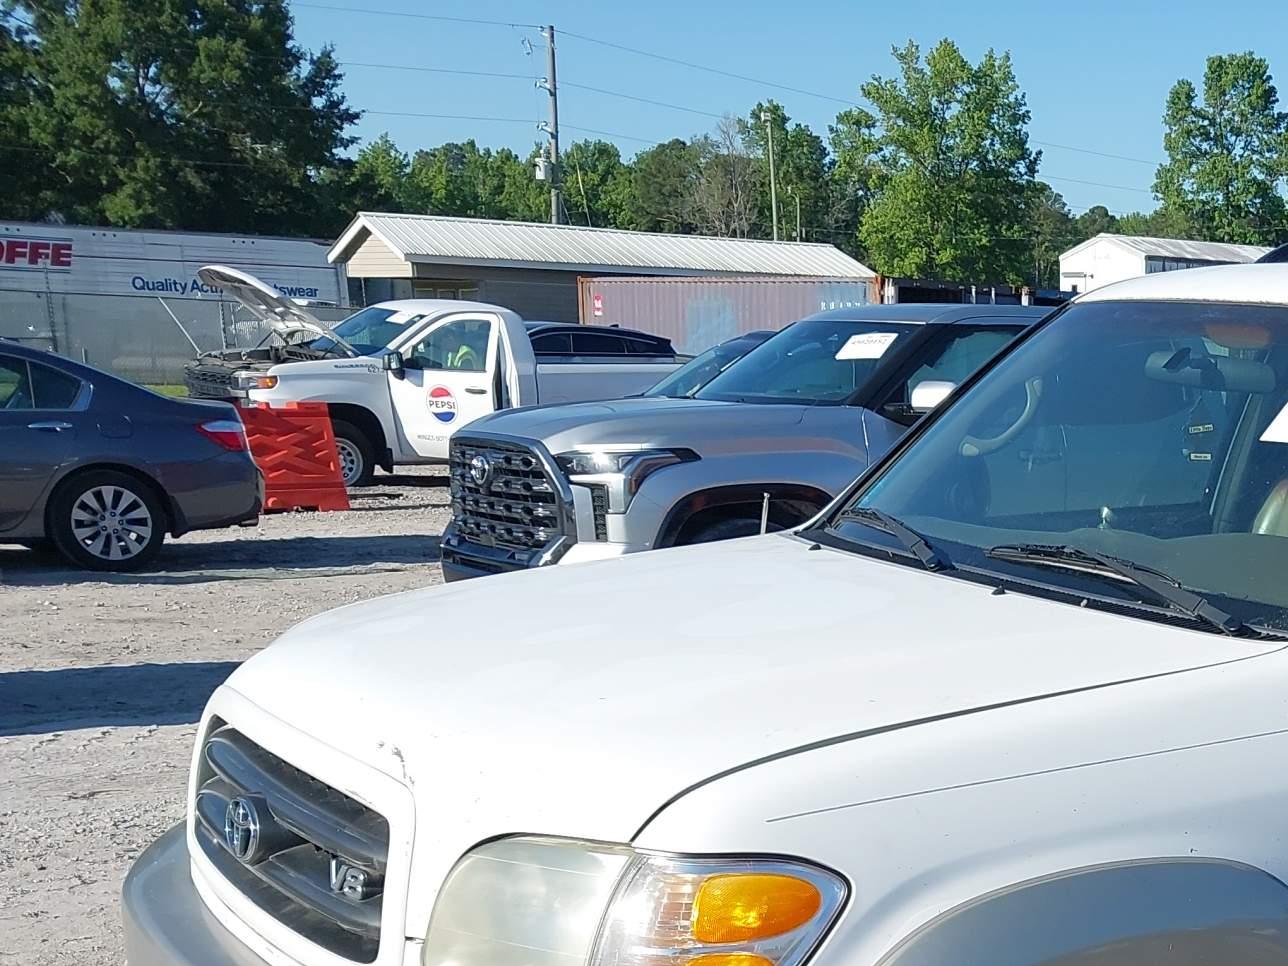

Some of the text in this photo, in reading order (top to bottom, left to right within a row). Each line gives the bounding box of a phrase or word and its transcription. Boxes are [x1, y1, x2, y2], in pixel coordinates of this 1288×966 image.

[0, 240, 73, 267] FFE
[132, 276, 188, 295] Quality
[428, 400, 456, 410] PEPSI
[330, 857, 368, 901] V8
